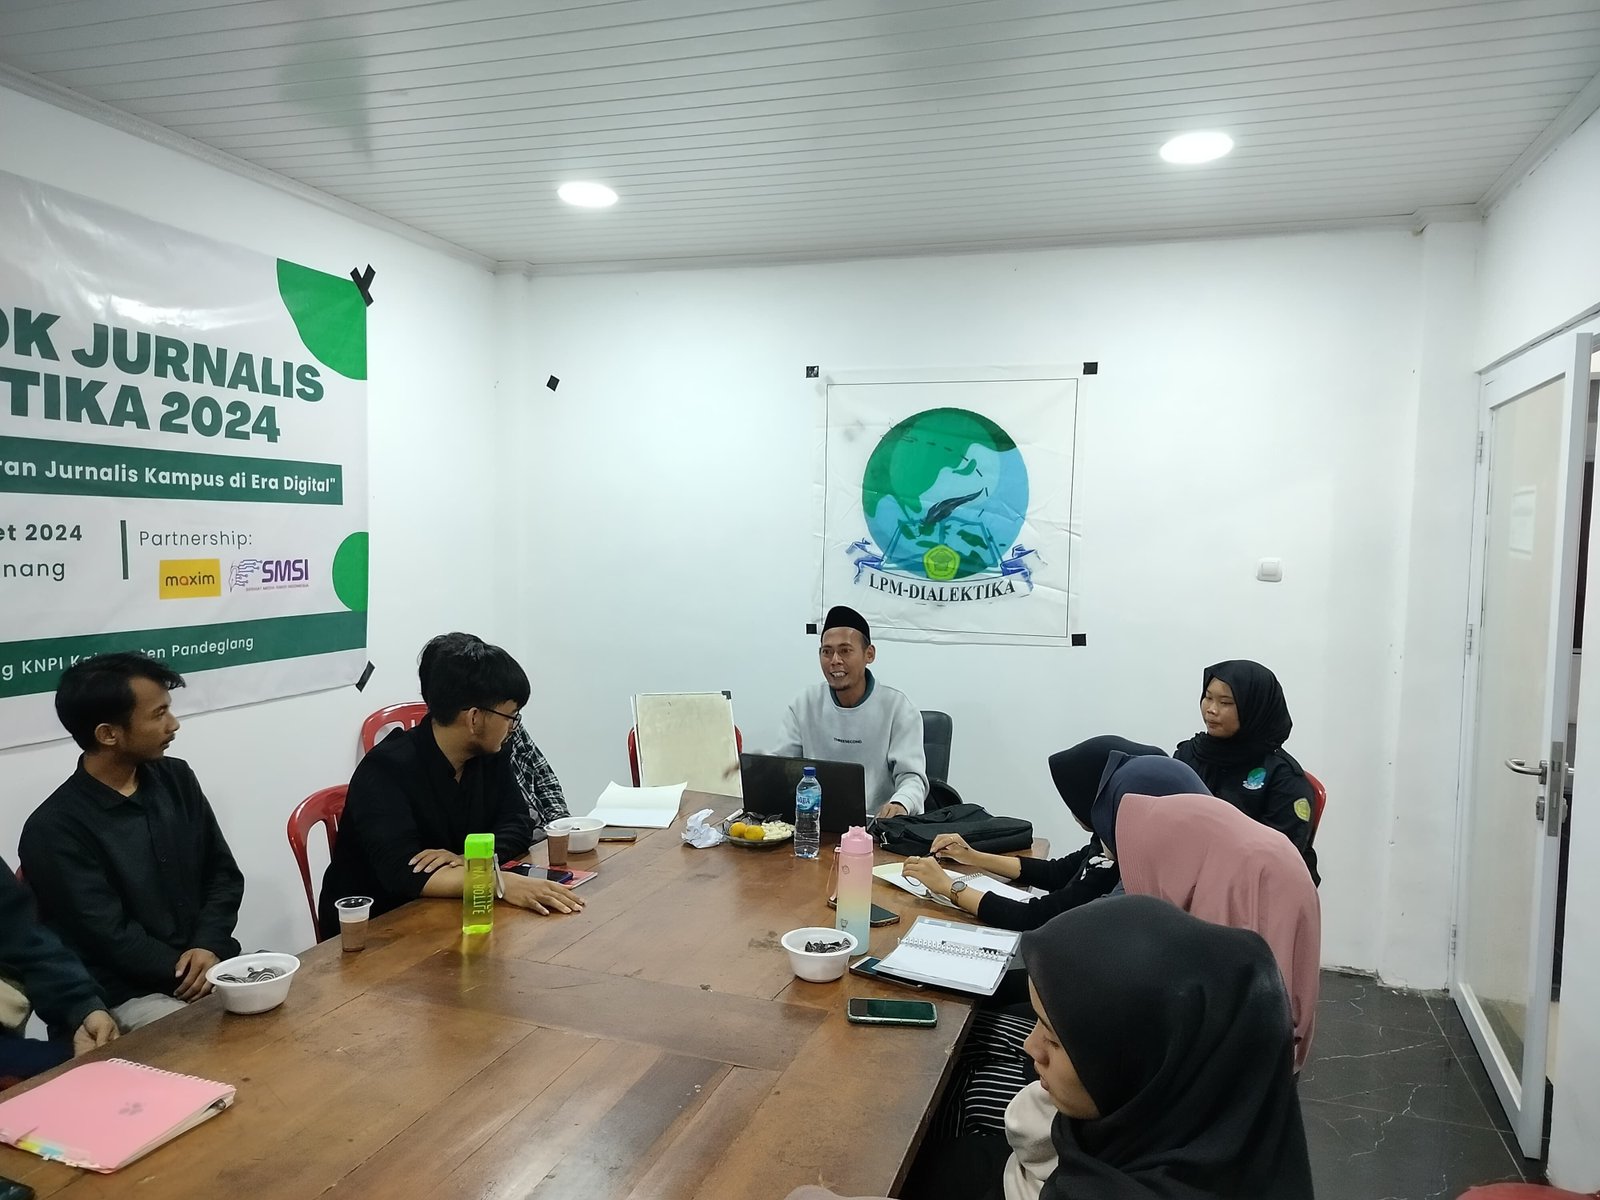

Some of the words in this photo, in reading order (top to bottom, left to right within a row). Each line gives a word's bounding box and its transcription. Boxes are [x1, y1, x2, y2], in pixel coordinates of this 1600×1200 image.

[0, 307, 60, 361] K
[71, 323, 324, 402] JURNALIS
[0, 366, 150, 430] TIKA
[159, 391, 280, 443] 2024
[0, 460, 37, 477] an
[45, 460, 138, 483] Jurnalis
[145, 467, 224, 490] Kampus
[229, 471, 246, 488] di
[252, 474, 279, 490] Era
[284, 476, 336, 495] Digital"
[25, 524, 82, 541] 2024
[139, 531, 252, 549] Partnership:
[3, 560, 65, 582] nang
[165, 572, 215, 587] maxim
[261, 559, 309, 583] SMSI
[869, 573, 1016, 601] LPM-DIALEKTIKA
[172, 636, 254, 656] Pandeglang
[22, 656, 63, 674] KNPI
